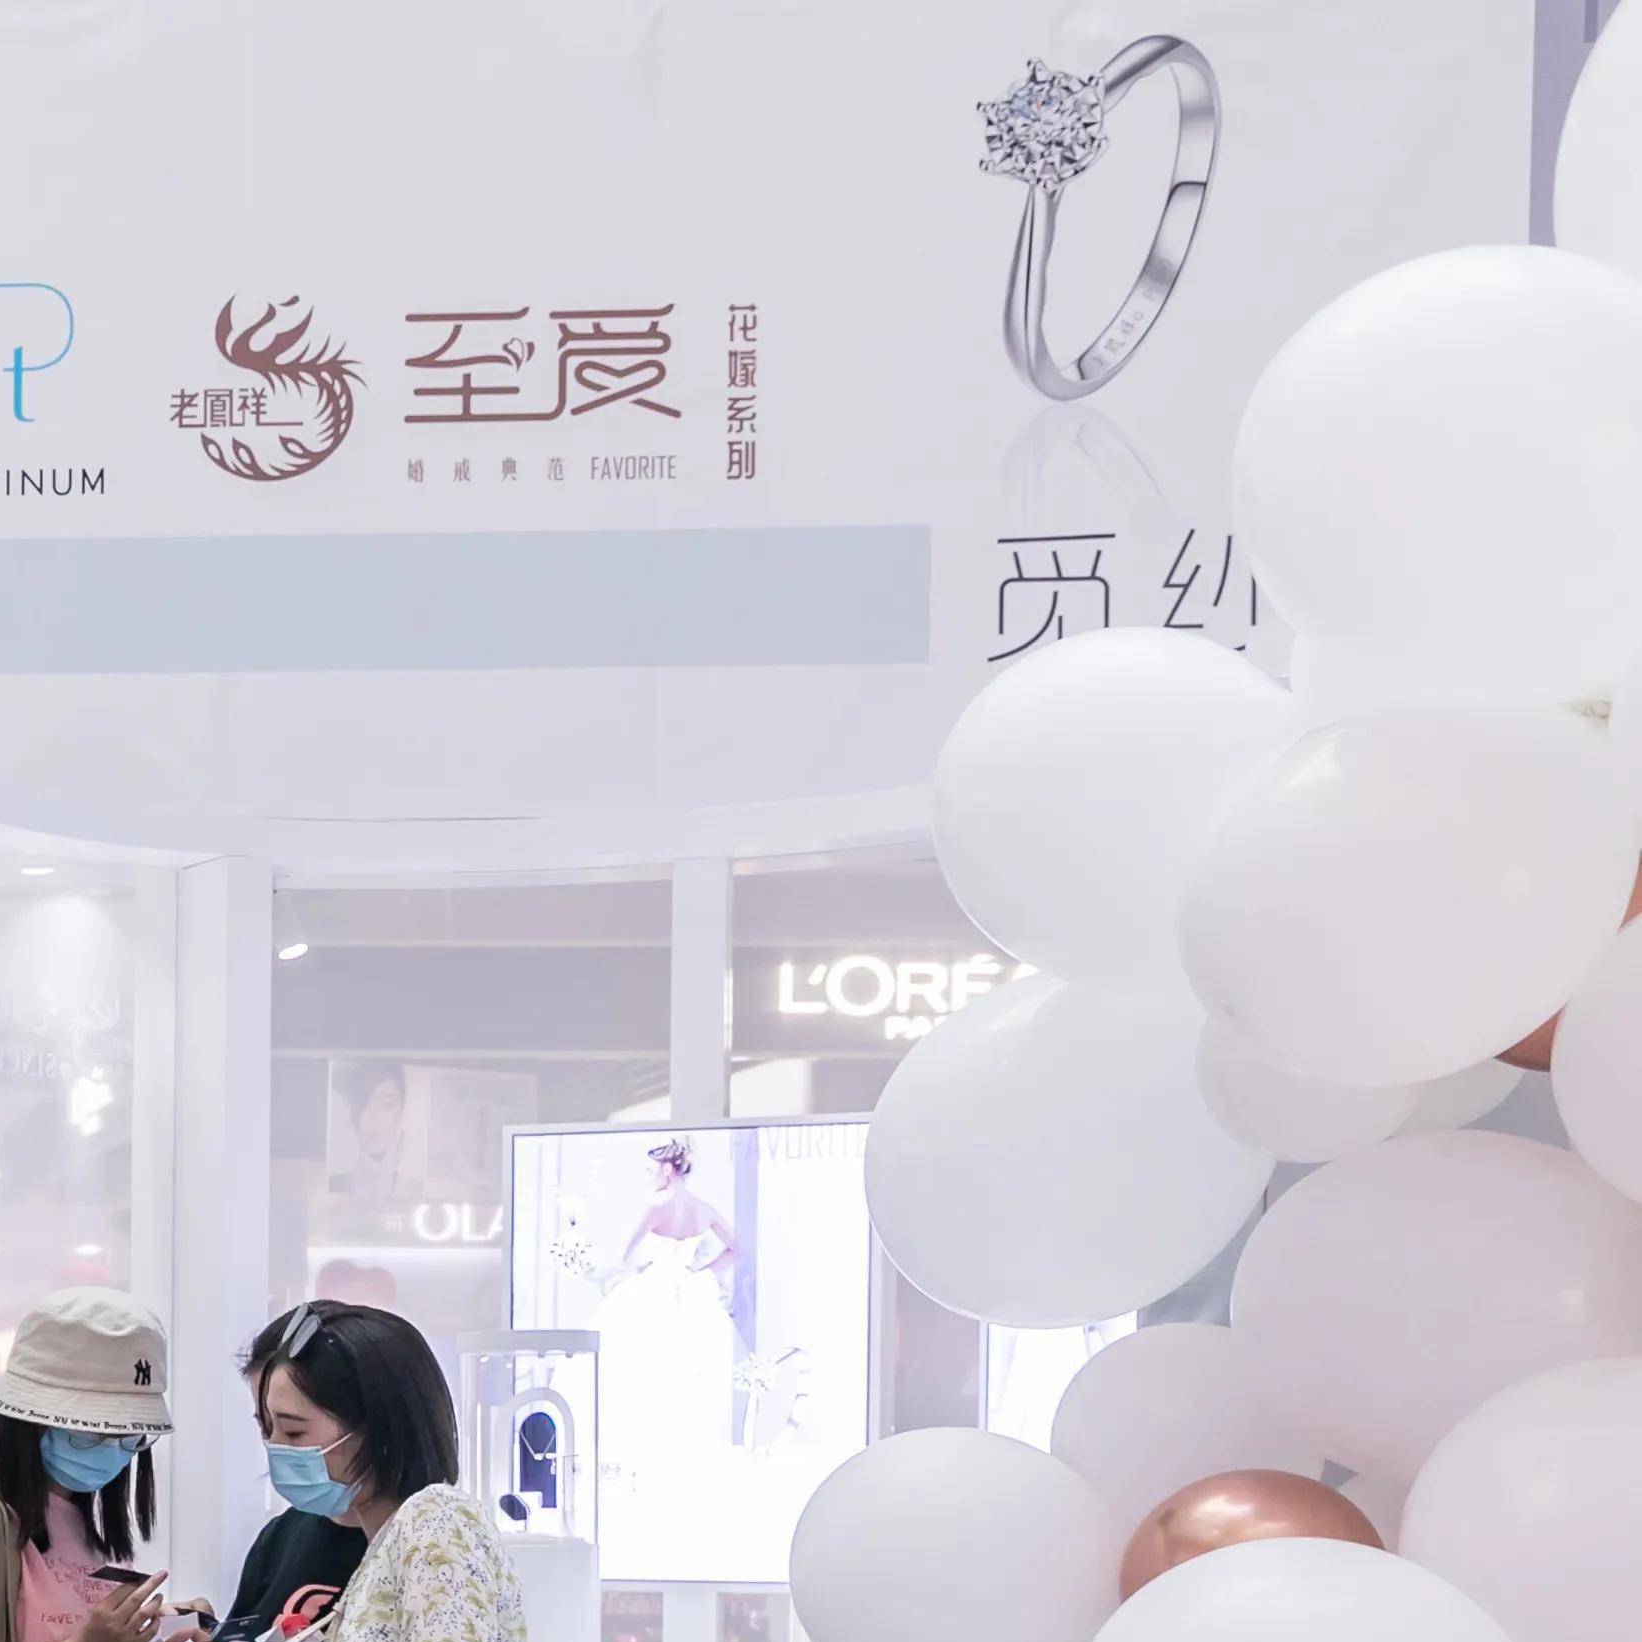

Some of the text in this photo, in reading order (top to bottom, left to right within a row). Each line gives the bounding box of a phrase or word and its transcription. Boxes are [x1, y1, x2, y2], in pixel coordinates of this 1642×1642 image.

[727, 303, 757, 481] 花嫁系列
[590, 454, 677, 481] FAVORITE
